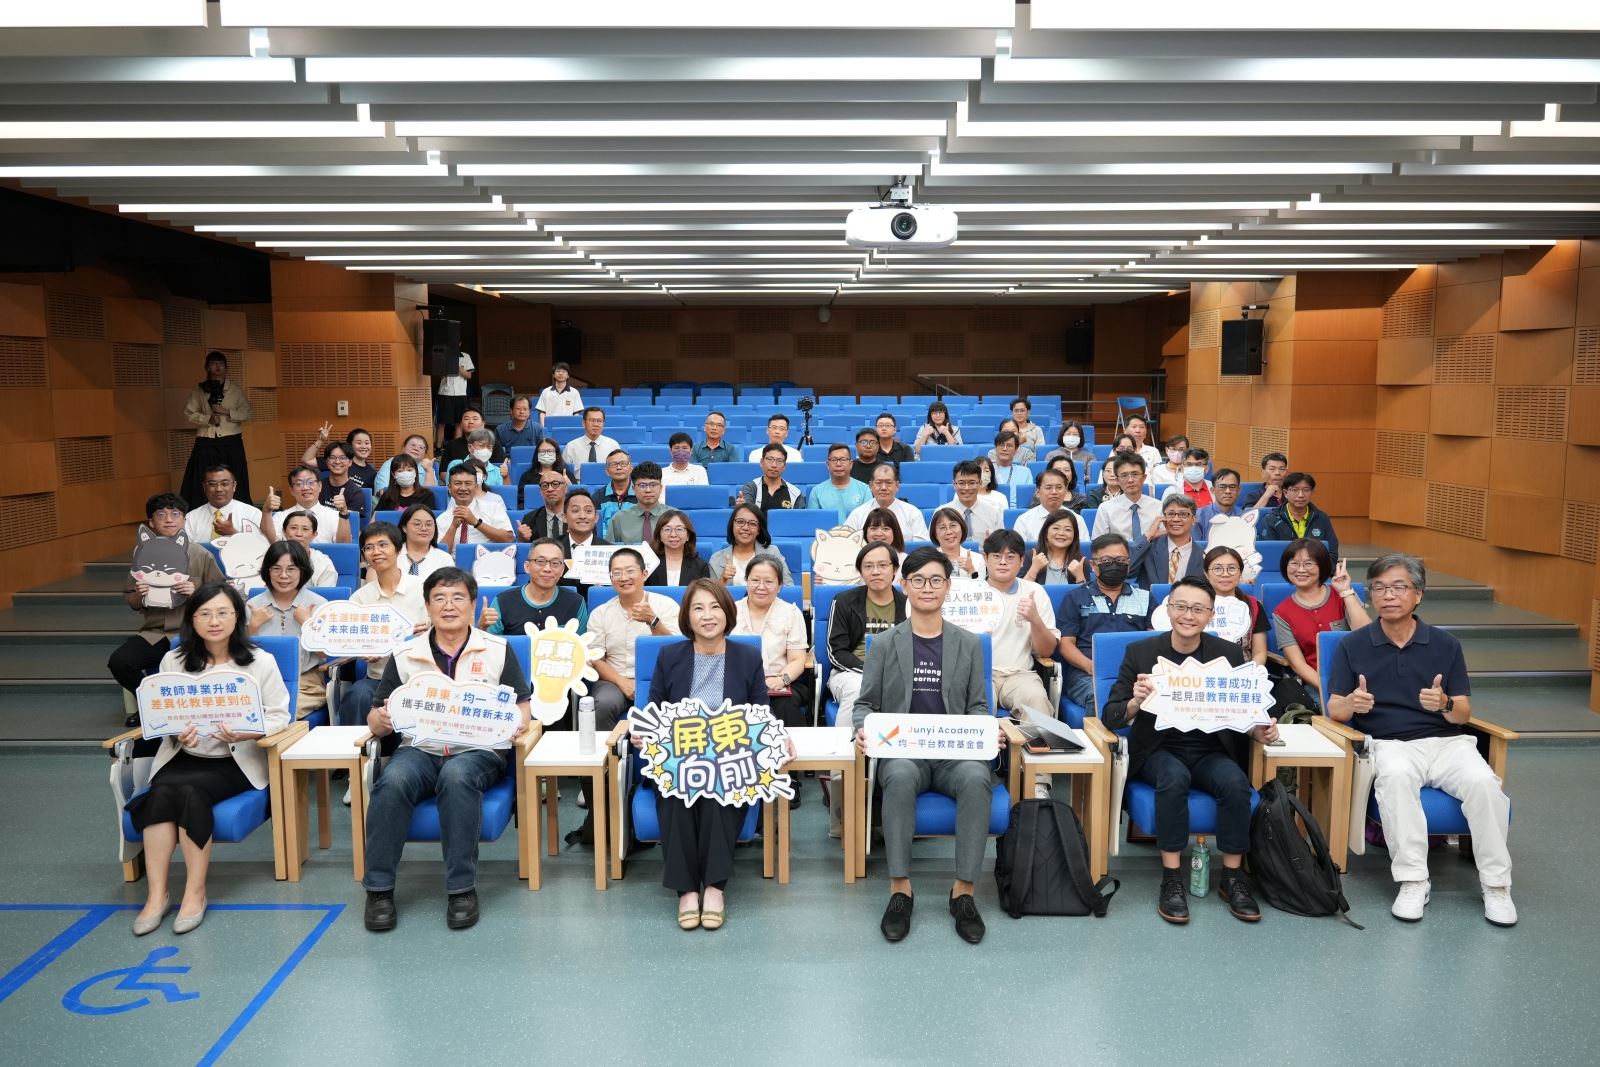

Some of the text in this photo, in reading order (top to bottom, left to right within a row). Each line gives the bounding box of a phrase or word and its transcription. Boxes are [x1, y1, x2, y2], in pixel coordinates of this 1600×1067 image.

[328, 624, 390, 634] 未來由我定義
[1168, 676, 1202, 688] MOU
[160, 683, 238, 696] 教師專業升級
[425, 687, 451, 700] 屏東
[463, 691, 487, 704] 均一
[151, 695, 252, 710] 差異化教學更到位
[1160, 690, 1262, 704] 一起見證教育新里程
[673, 712, 750, 756] 屏東
[908, 726, 985, 736] Junyi Academy
[898, 739, 985, 750] 均一平台教育基金會
[679, 747, 757, 793] 向前
